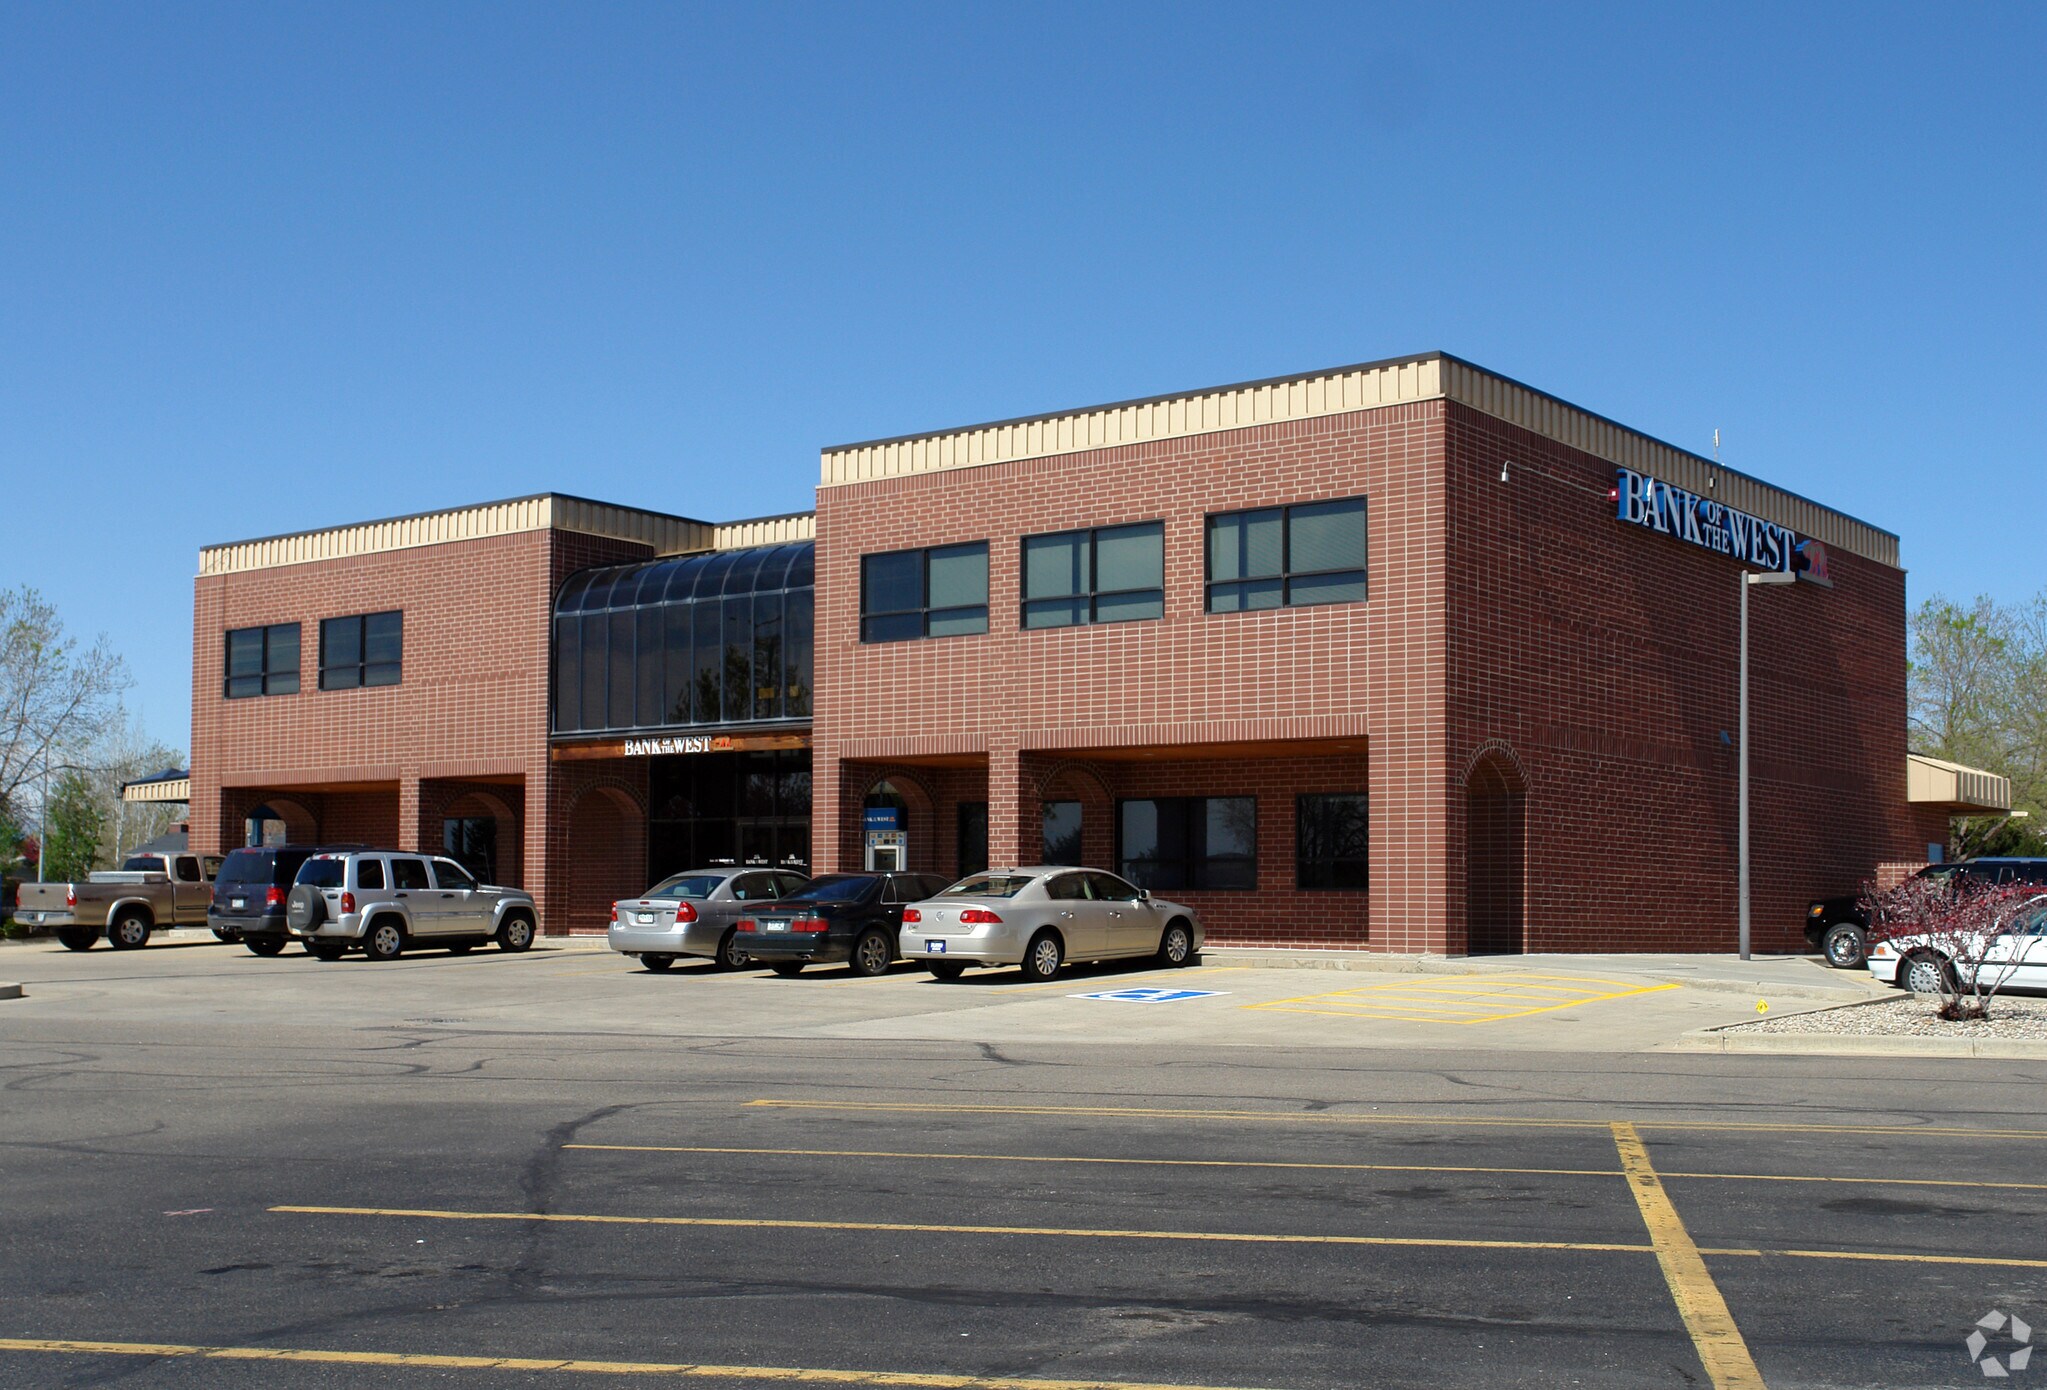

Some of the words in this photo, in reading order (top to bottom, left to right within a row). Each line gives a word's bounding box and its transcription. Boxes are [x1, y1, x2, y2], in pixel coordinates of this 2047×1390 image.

[1618, 468, 1704, 546] BANK
[1706, 500, 1724, 526] OF
[1703, 522, 1730, 554] THE
[1726, 507, 1796, 573] WEST
[624, 738, 662, 756] BANK
[661, 745, 675, 754] THE
[662, 737, 671, 746] OF
[673, 735, 712, 753] WEST
